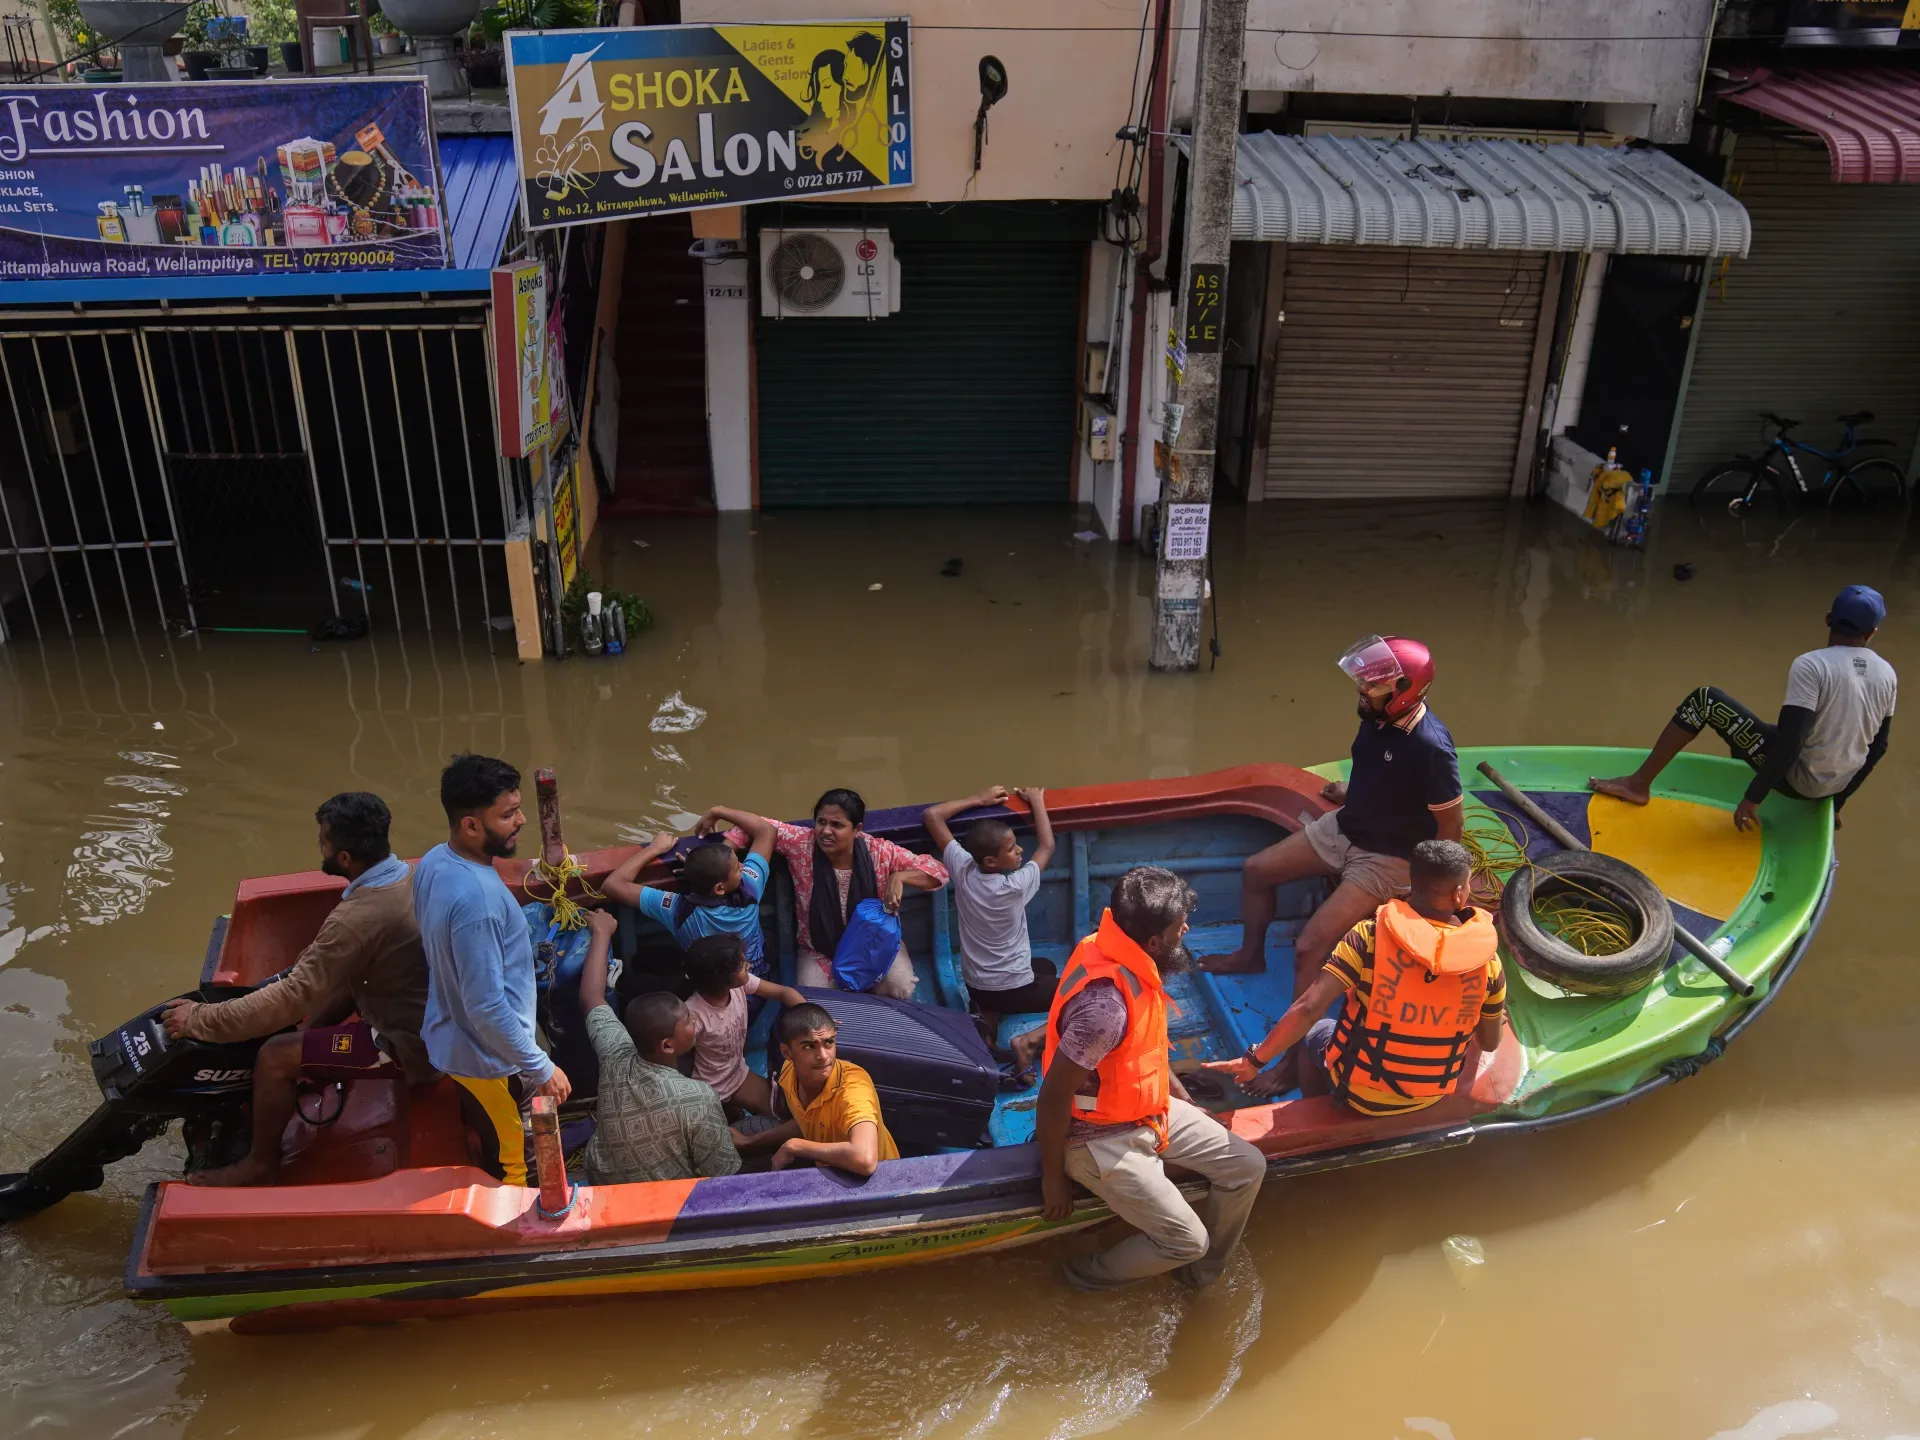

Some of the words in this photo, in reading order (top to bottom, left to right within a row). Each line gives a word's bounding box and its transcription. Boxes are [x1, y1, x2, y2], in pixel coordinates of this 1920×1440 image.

[743, 39, 782, 52] Ladies
[787, 38, 796, 50] &
[758, 54, 795, 66] Gents
[774, 68, 808, 81] Salon
[890, 36, 906, 172] SALON
[0, 91, 210, 161] Fashion
[798, 175, 823, 188] 0722
[825, 172, 844, 185] 875
[846, 170, 863, 183] 737
[557, 203, 593, 217] No.12,
[106, 257, 150, 275] Road,
[155, 255, 253, 273] Wellampitiya
[263, 254, 299, 268] TEL:
[303, 251, 395, 267] 0773790004
[857, 265, 875, 276] LG
[518, 274, 543, 295] Ashoka
[1195, 275, 1219, 289] AS
[708, 288, 743, 298] 12/1/1
[1195, 293, 1219, 307] 72
[1188, 325, 1198, 339] 1
[1204, 325, 1217, 340] E
[526, 294, 542, 426] SALON
[131, 1030, 151, 1057] 25
[120, 1030, 142, 1074] KEROSENE
